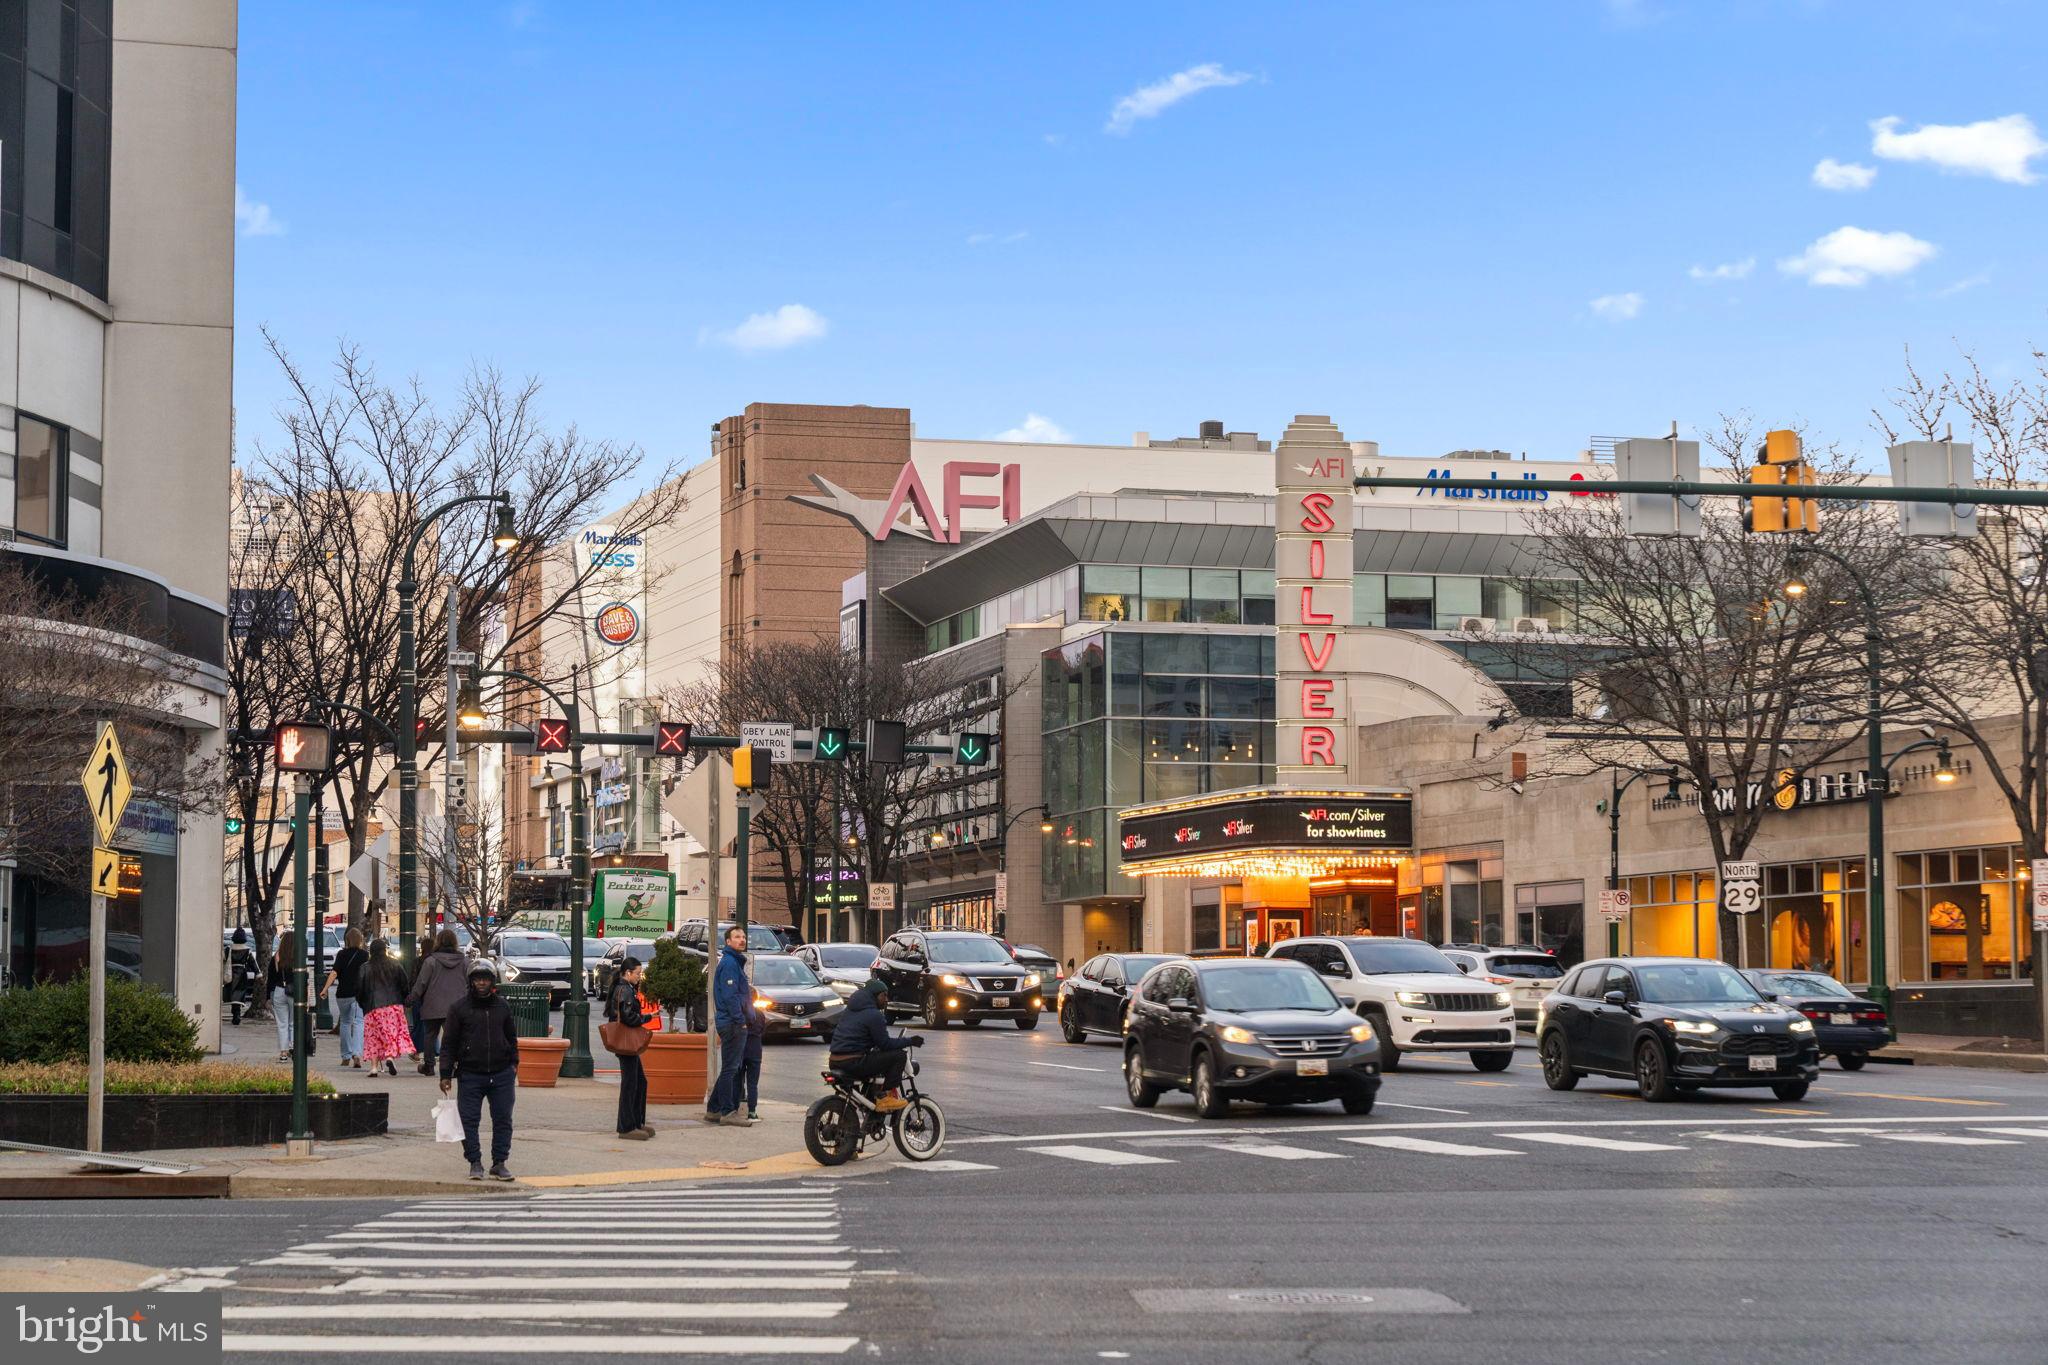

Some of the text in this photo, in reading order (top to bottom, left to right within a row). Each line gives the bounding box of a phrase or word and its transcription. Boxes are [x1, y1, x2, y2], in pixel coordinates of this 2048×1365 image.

[1309, 458, 1344, 478] AFI
[875, 459, 1021, 544] AFI
[1300, 493, 1336, 765] SILVER
[769, 728, 790, 736] LANE
[747, 739, 786, 747] CONTROL
[1308, 807, 1385, 823] AFI.com/Silver
[1307, 825, 1386, 838] for showtimes
[1725, 865, 1757, 876] NORTH
[607, 881, 668, 892] Peter Pan
[1728, 888, 1756, 906] 29
[556, 914, 572, 931] Pa
[606, 924, 665, 933] PeterPanBus.com
